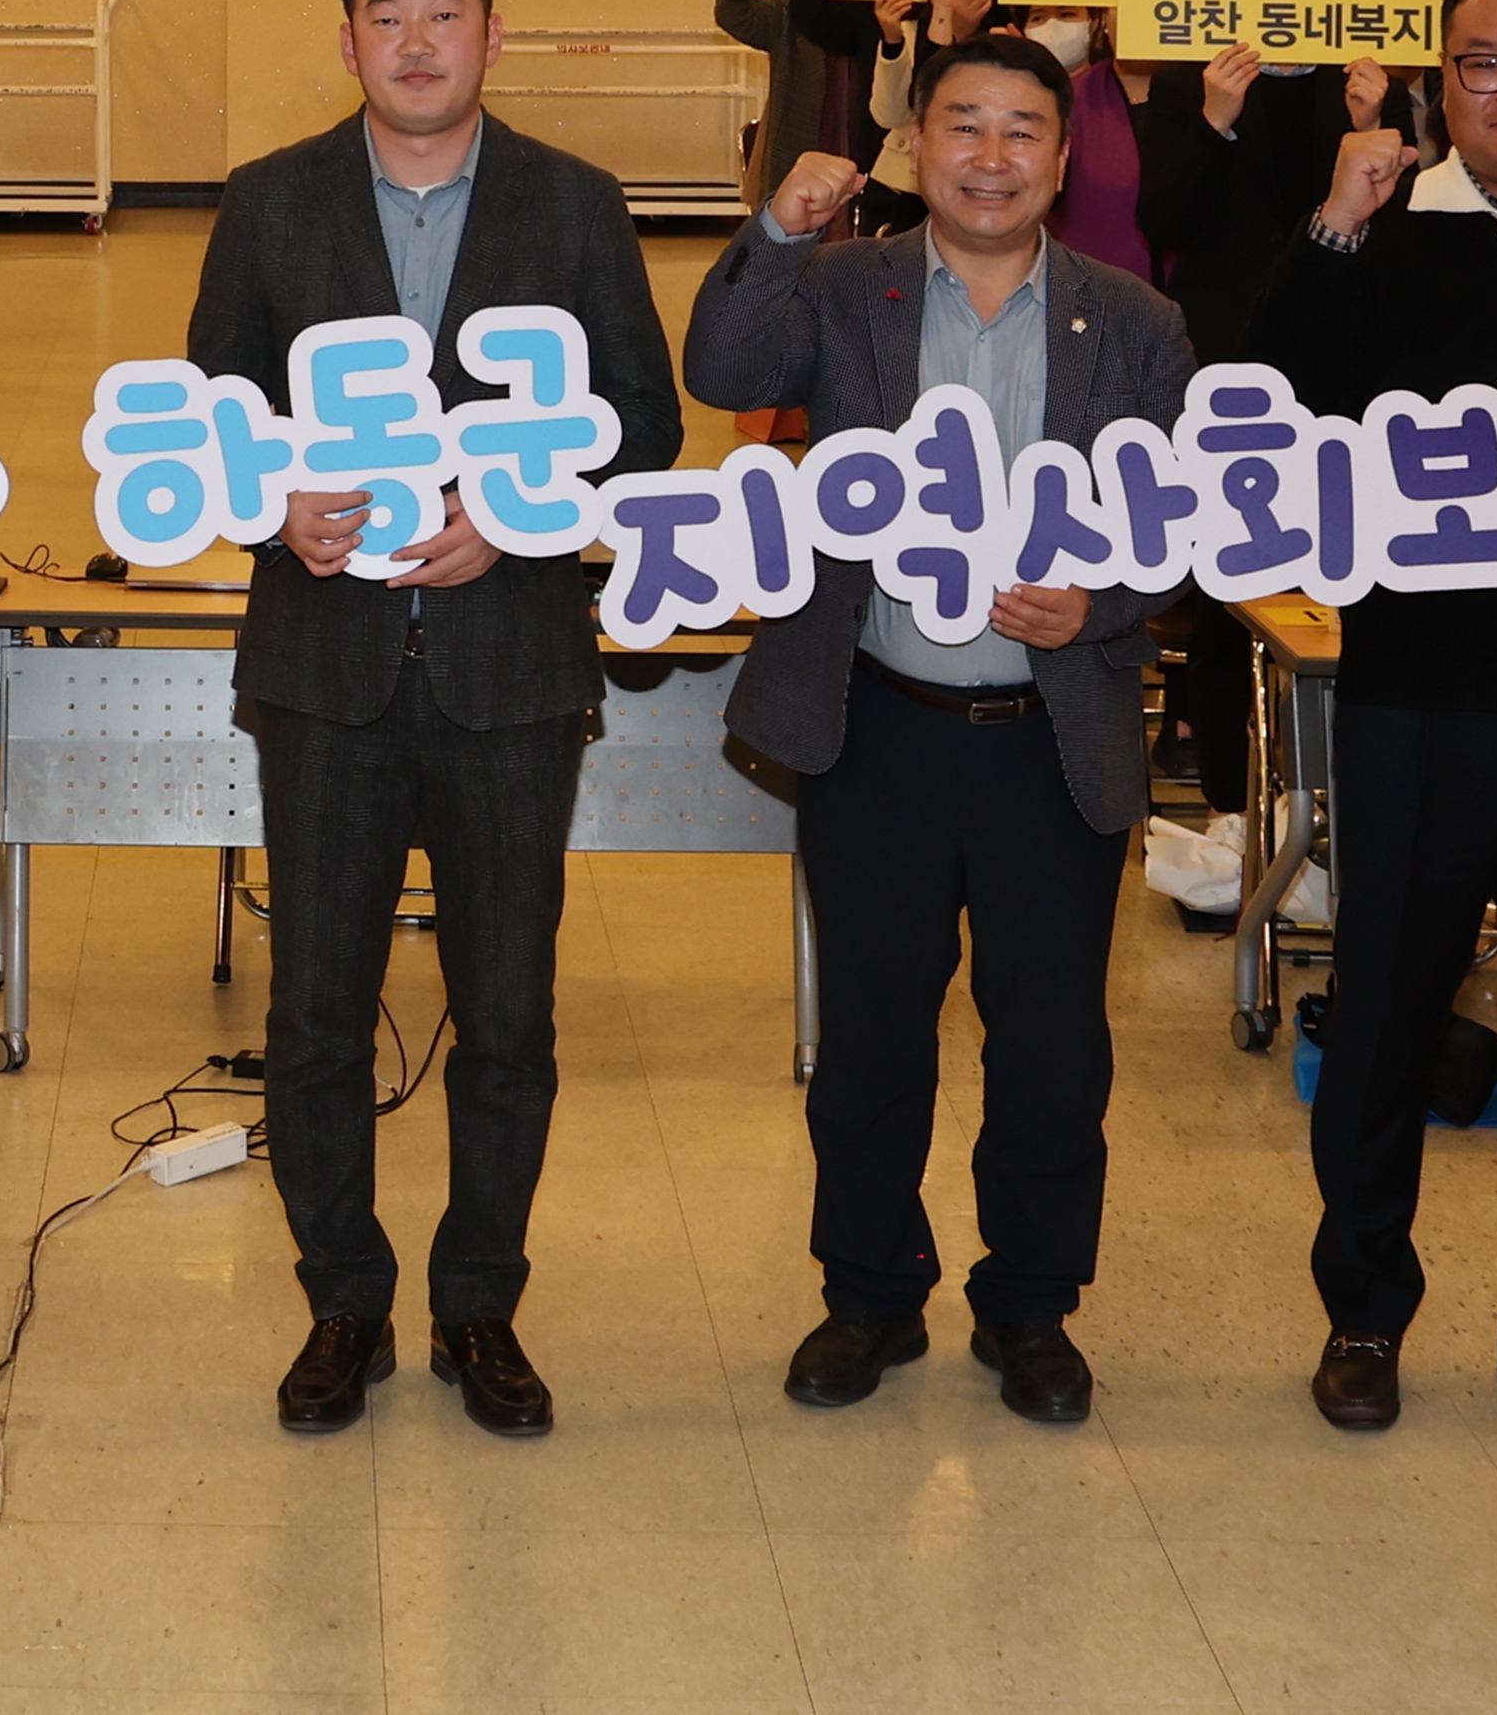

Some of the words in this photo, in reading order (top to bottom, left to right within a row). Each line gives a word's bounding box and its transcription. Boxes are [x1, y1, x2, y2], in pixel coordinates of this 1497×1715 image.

[1153, 0, 1243, 47] 알찬
[1256, 1, 1434, 52] 동네복지
[104, 327, 598, 556] 하동군
